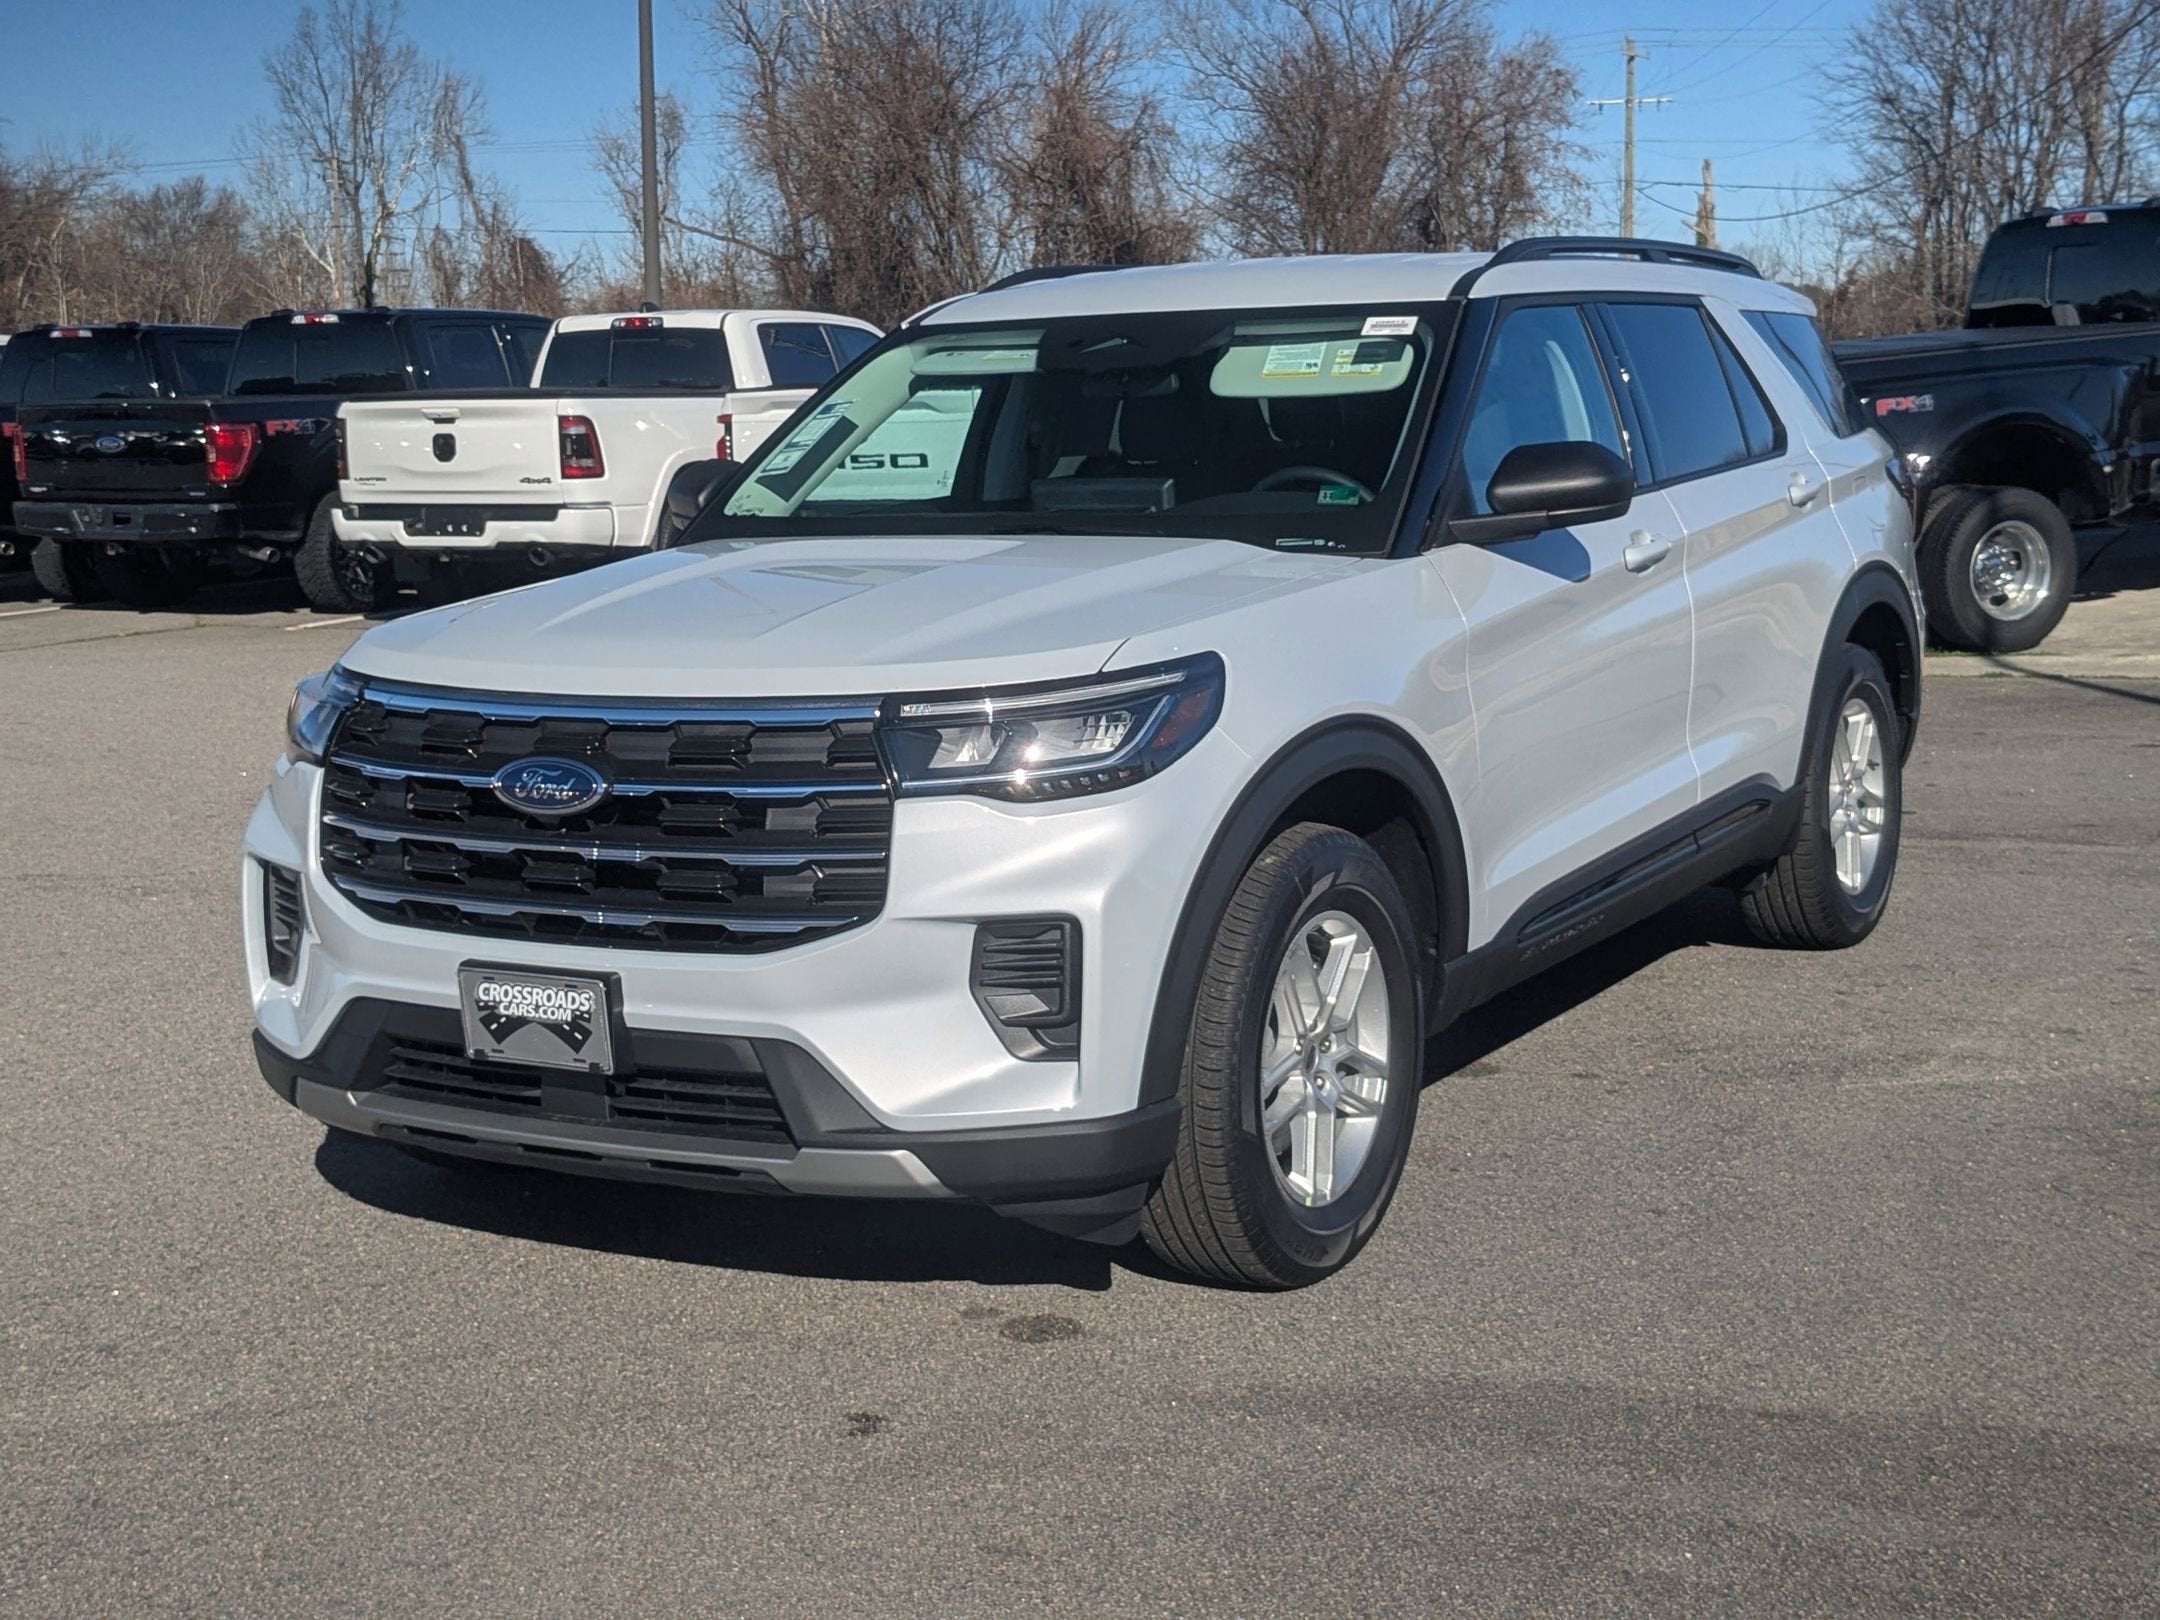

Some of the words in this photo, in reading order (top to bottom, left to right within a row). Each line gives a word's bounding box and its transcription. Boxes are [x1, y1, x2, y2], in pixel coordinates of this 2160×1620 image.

[1876, 394, 1934, 416] FX4
[515, 767, 577, 800] Ford
[478, 982, 592, 1012] CROSSROADS
[500, 1002, 572, 1022] CARS.COM
